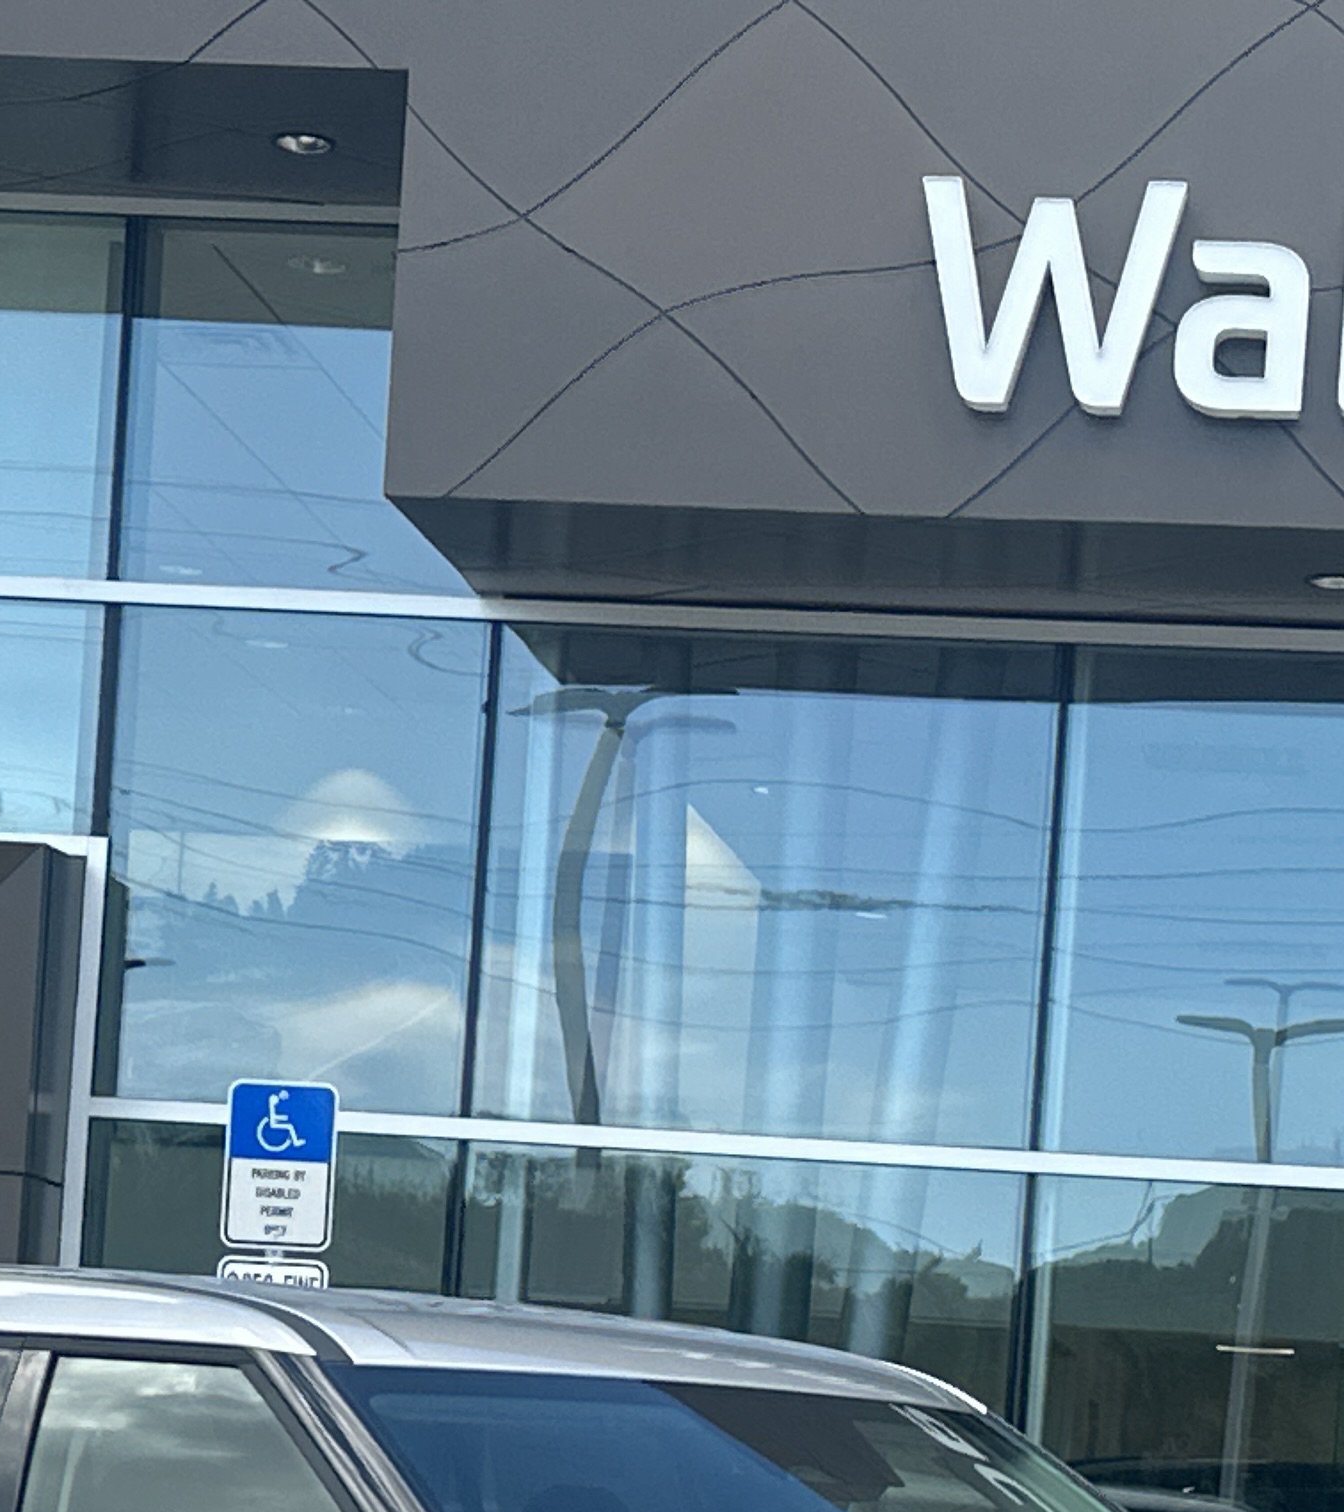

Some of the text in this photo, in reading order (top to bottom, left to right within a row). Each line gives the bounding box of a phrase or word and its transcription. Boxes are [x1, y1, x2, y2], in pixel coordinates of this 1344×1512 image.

[251, 1167, 307, 1182] PARKING BY
[255, 1187, 302, 1200] DISABLED
[259, 1205, 294, 1218] PERMIT
